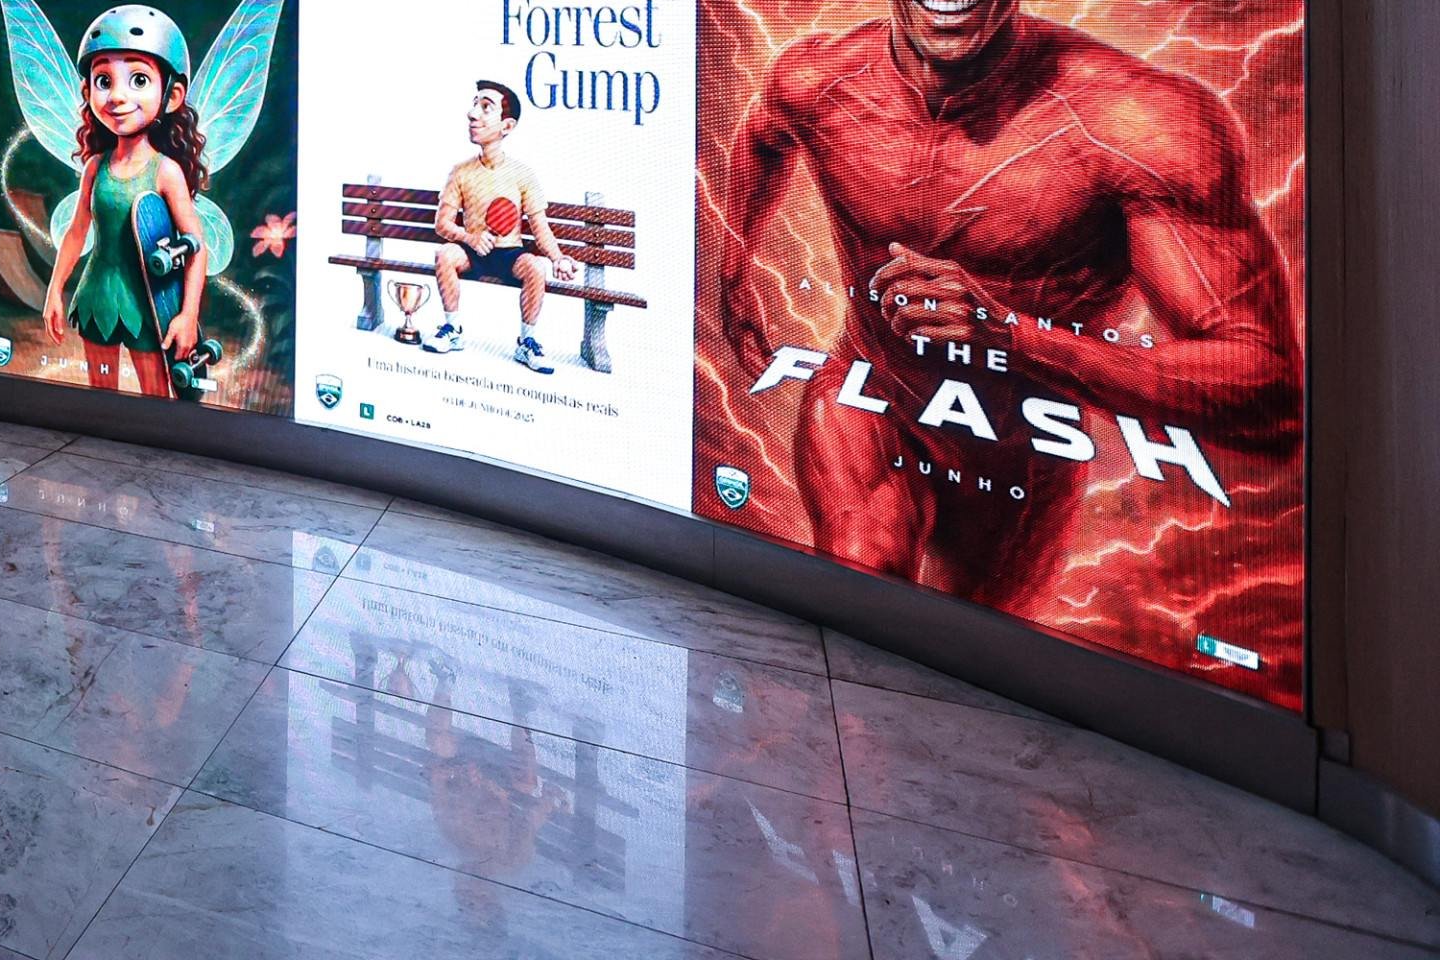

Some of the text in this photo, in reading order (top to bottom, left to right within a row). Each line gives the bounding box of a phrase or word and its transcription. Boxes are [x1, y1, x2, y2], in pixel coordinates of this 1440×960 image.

[525, 50, 661, 126] Gump
[798, 278, 1155, 350] ALISON SANTOS
[40, 355, 131, 377] JUNHO
[910, 334, 1009, 373] THE
[516, 385, 583, 409] conquistas
[586, 400, 620, 418] reais
[748, 344, 1232, 508] FLASH
[893, 455, 1026, 502] JUNHO
